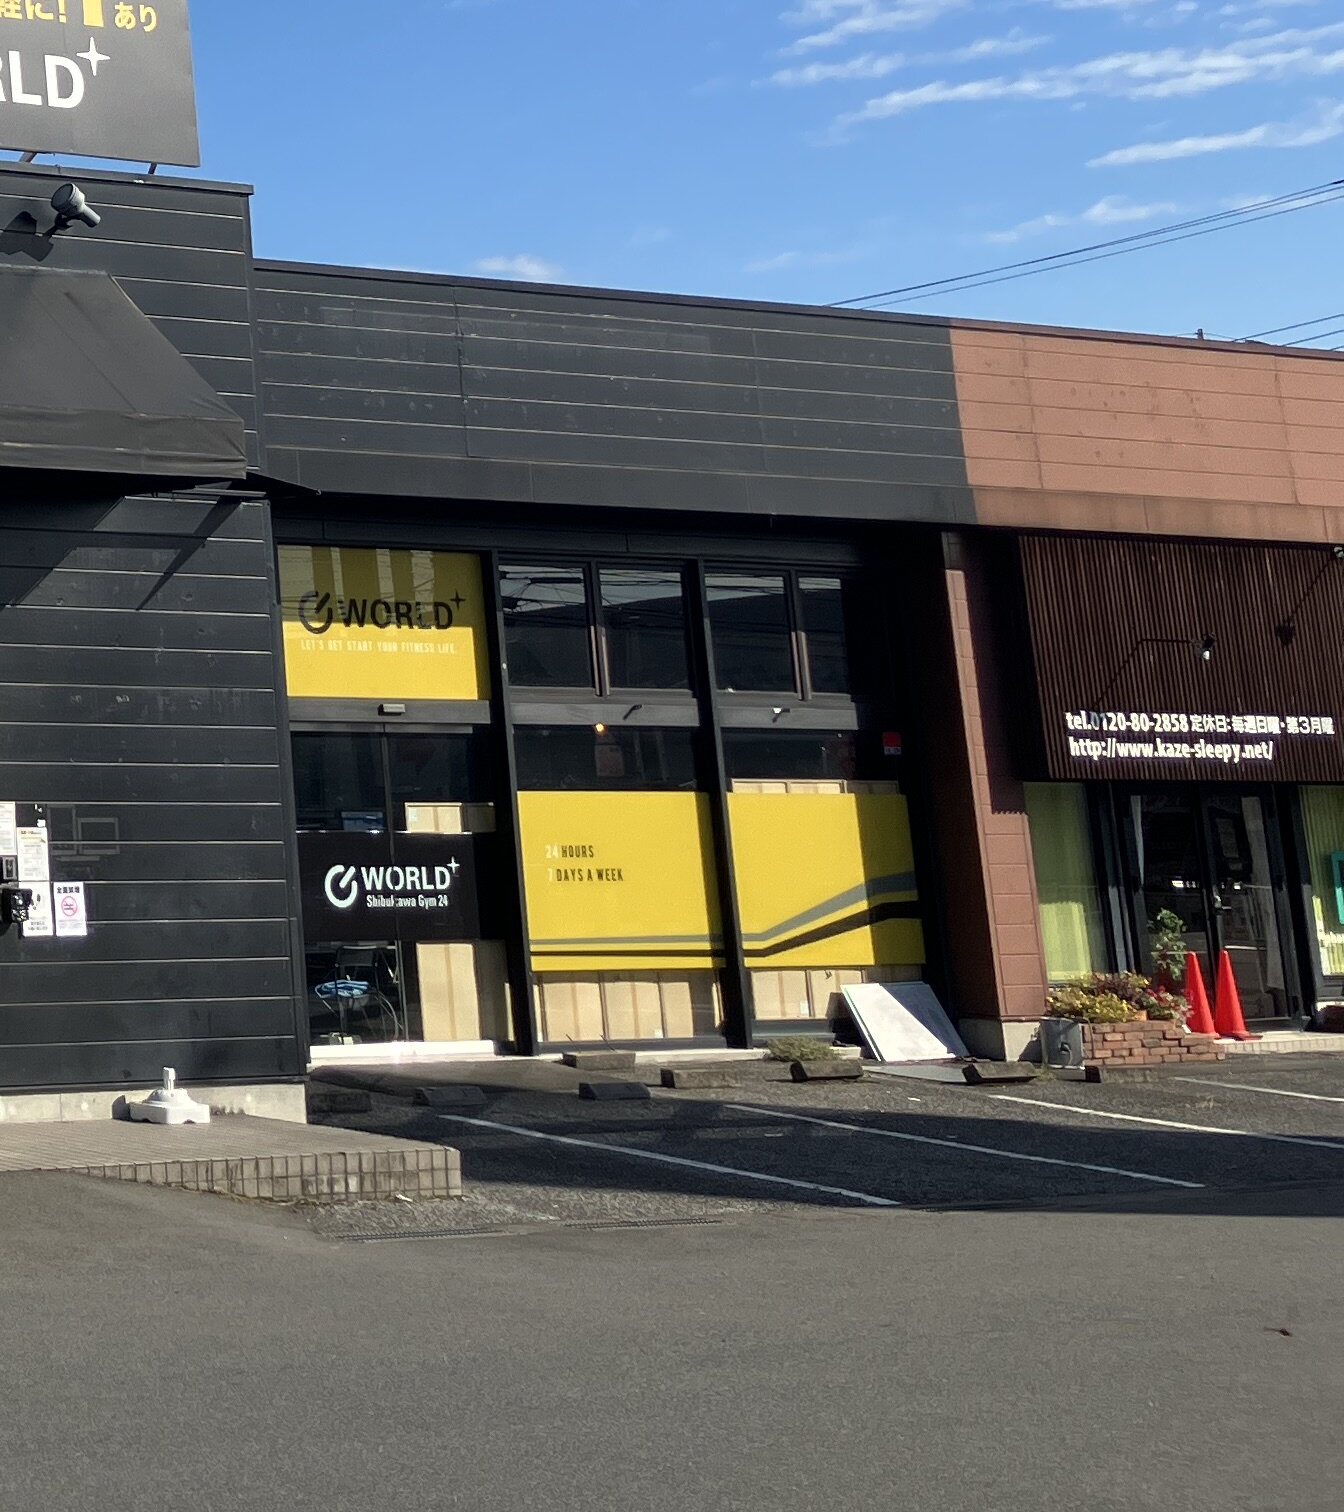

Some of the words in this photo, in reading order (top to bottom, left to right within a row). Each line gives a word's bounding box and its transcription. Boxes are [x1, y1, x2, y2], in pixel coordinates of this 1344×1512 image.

[114, 1, 158, 33] あり
[1068, 737, 1273, 764] http://www.kaze-sleepy.net/
[545, 845, 559, 858] 24
[561, 845, 594, 859] HOURS
[556, 868, 584, 882] DAYS
[587, 868, 594, 882] A
[596, 868, 624, 882] WEEK
[418, 894, 437, 909] Gym
[438, 894, 448, 907] 24
